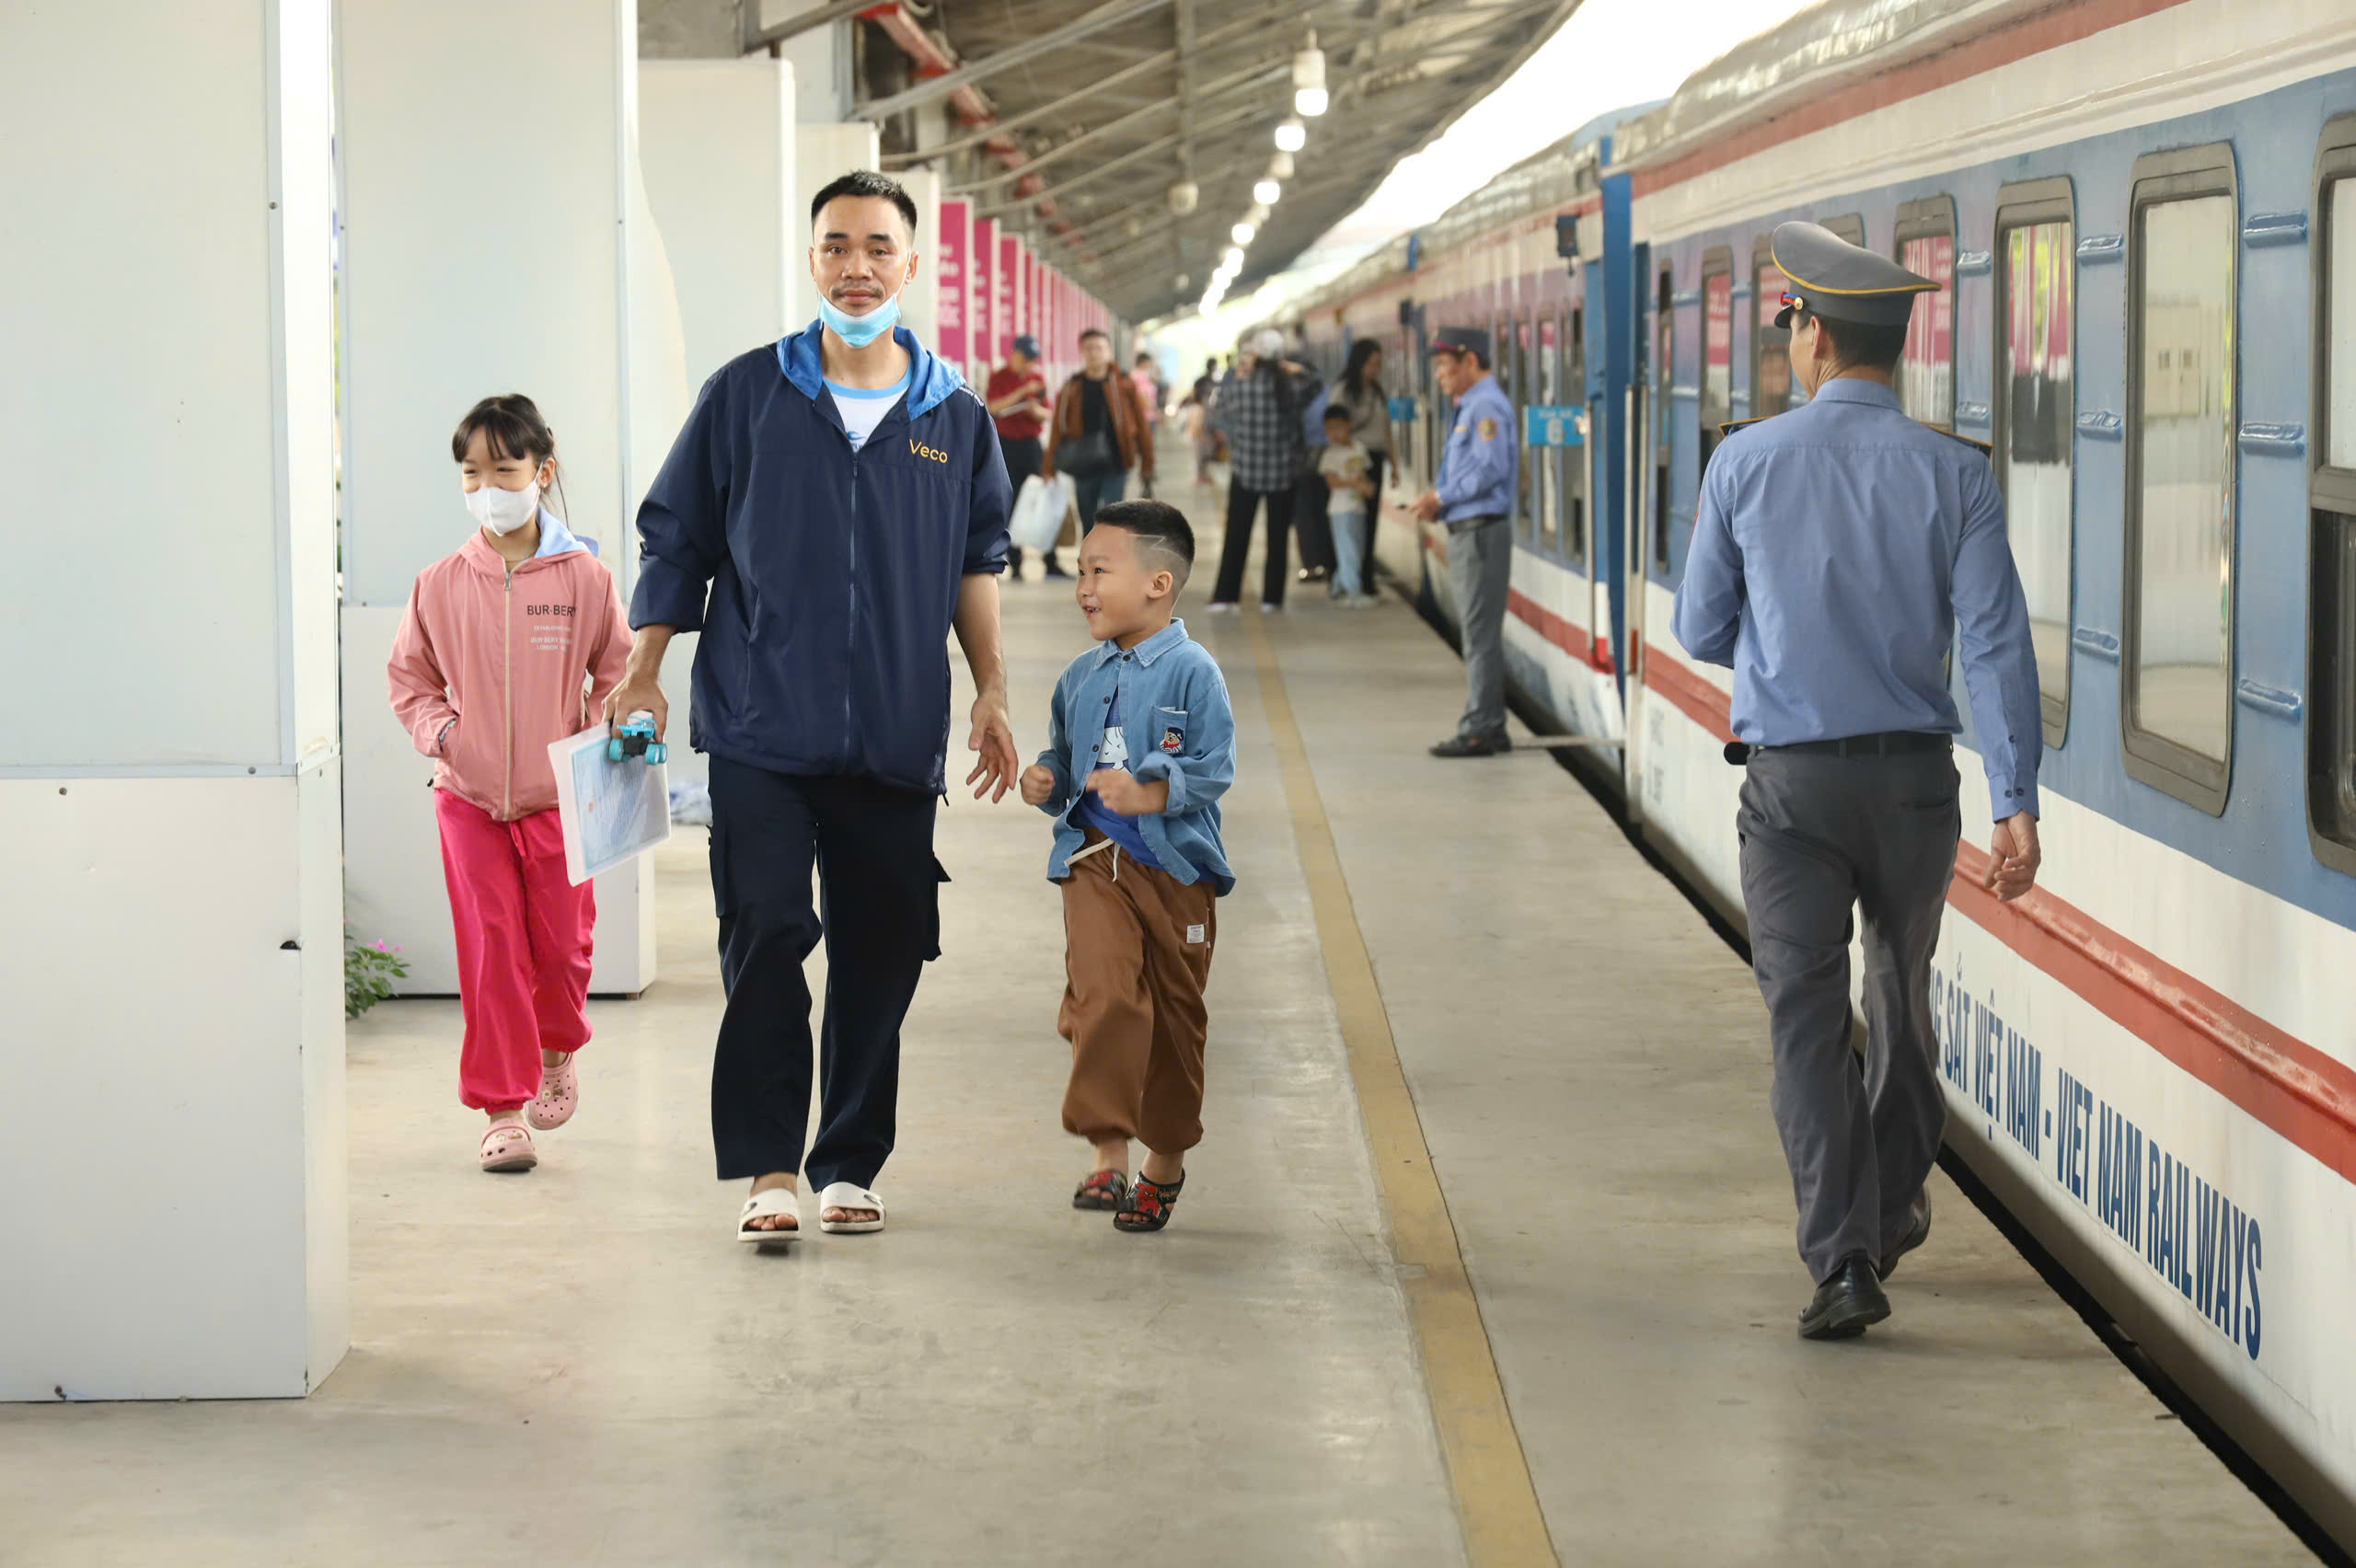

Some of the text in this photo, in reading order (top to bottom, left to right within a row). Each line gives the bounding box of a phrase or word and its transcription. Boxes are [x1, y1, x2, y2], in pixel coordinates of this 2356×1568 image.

[909, 438, 948, 464] Veco
[1975, 988, 2003, 1141] VIỆT
[2006, 1026, 2041, 1162] NAM
[2057, 1066, 2093, 1207] VIET
[2098, 1100, 2142, 1253] NAM
[2147, 1138, 2262, 1361] RAILWAYS
